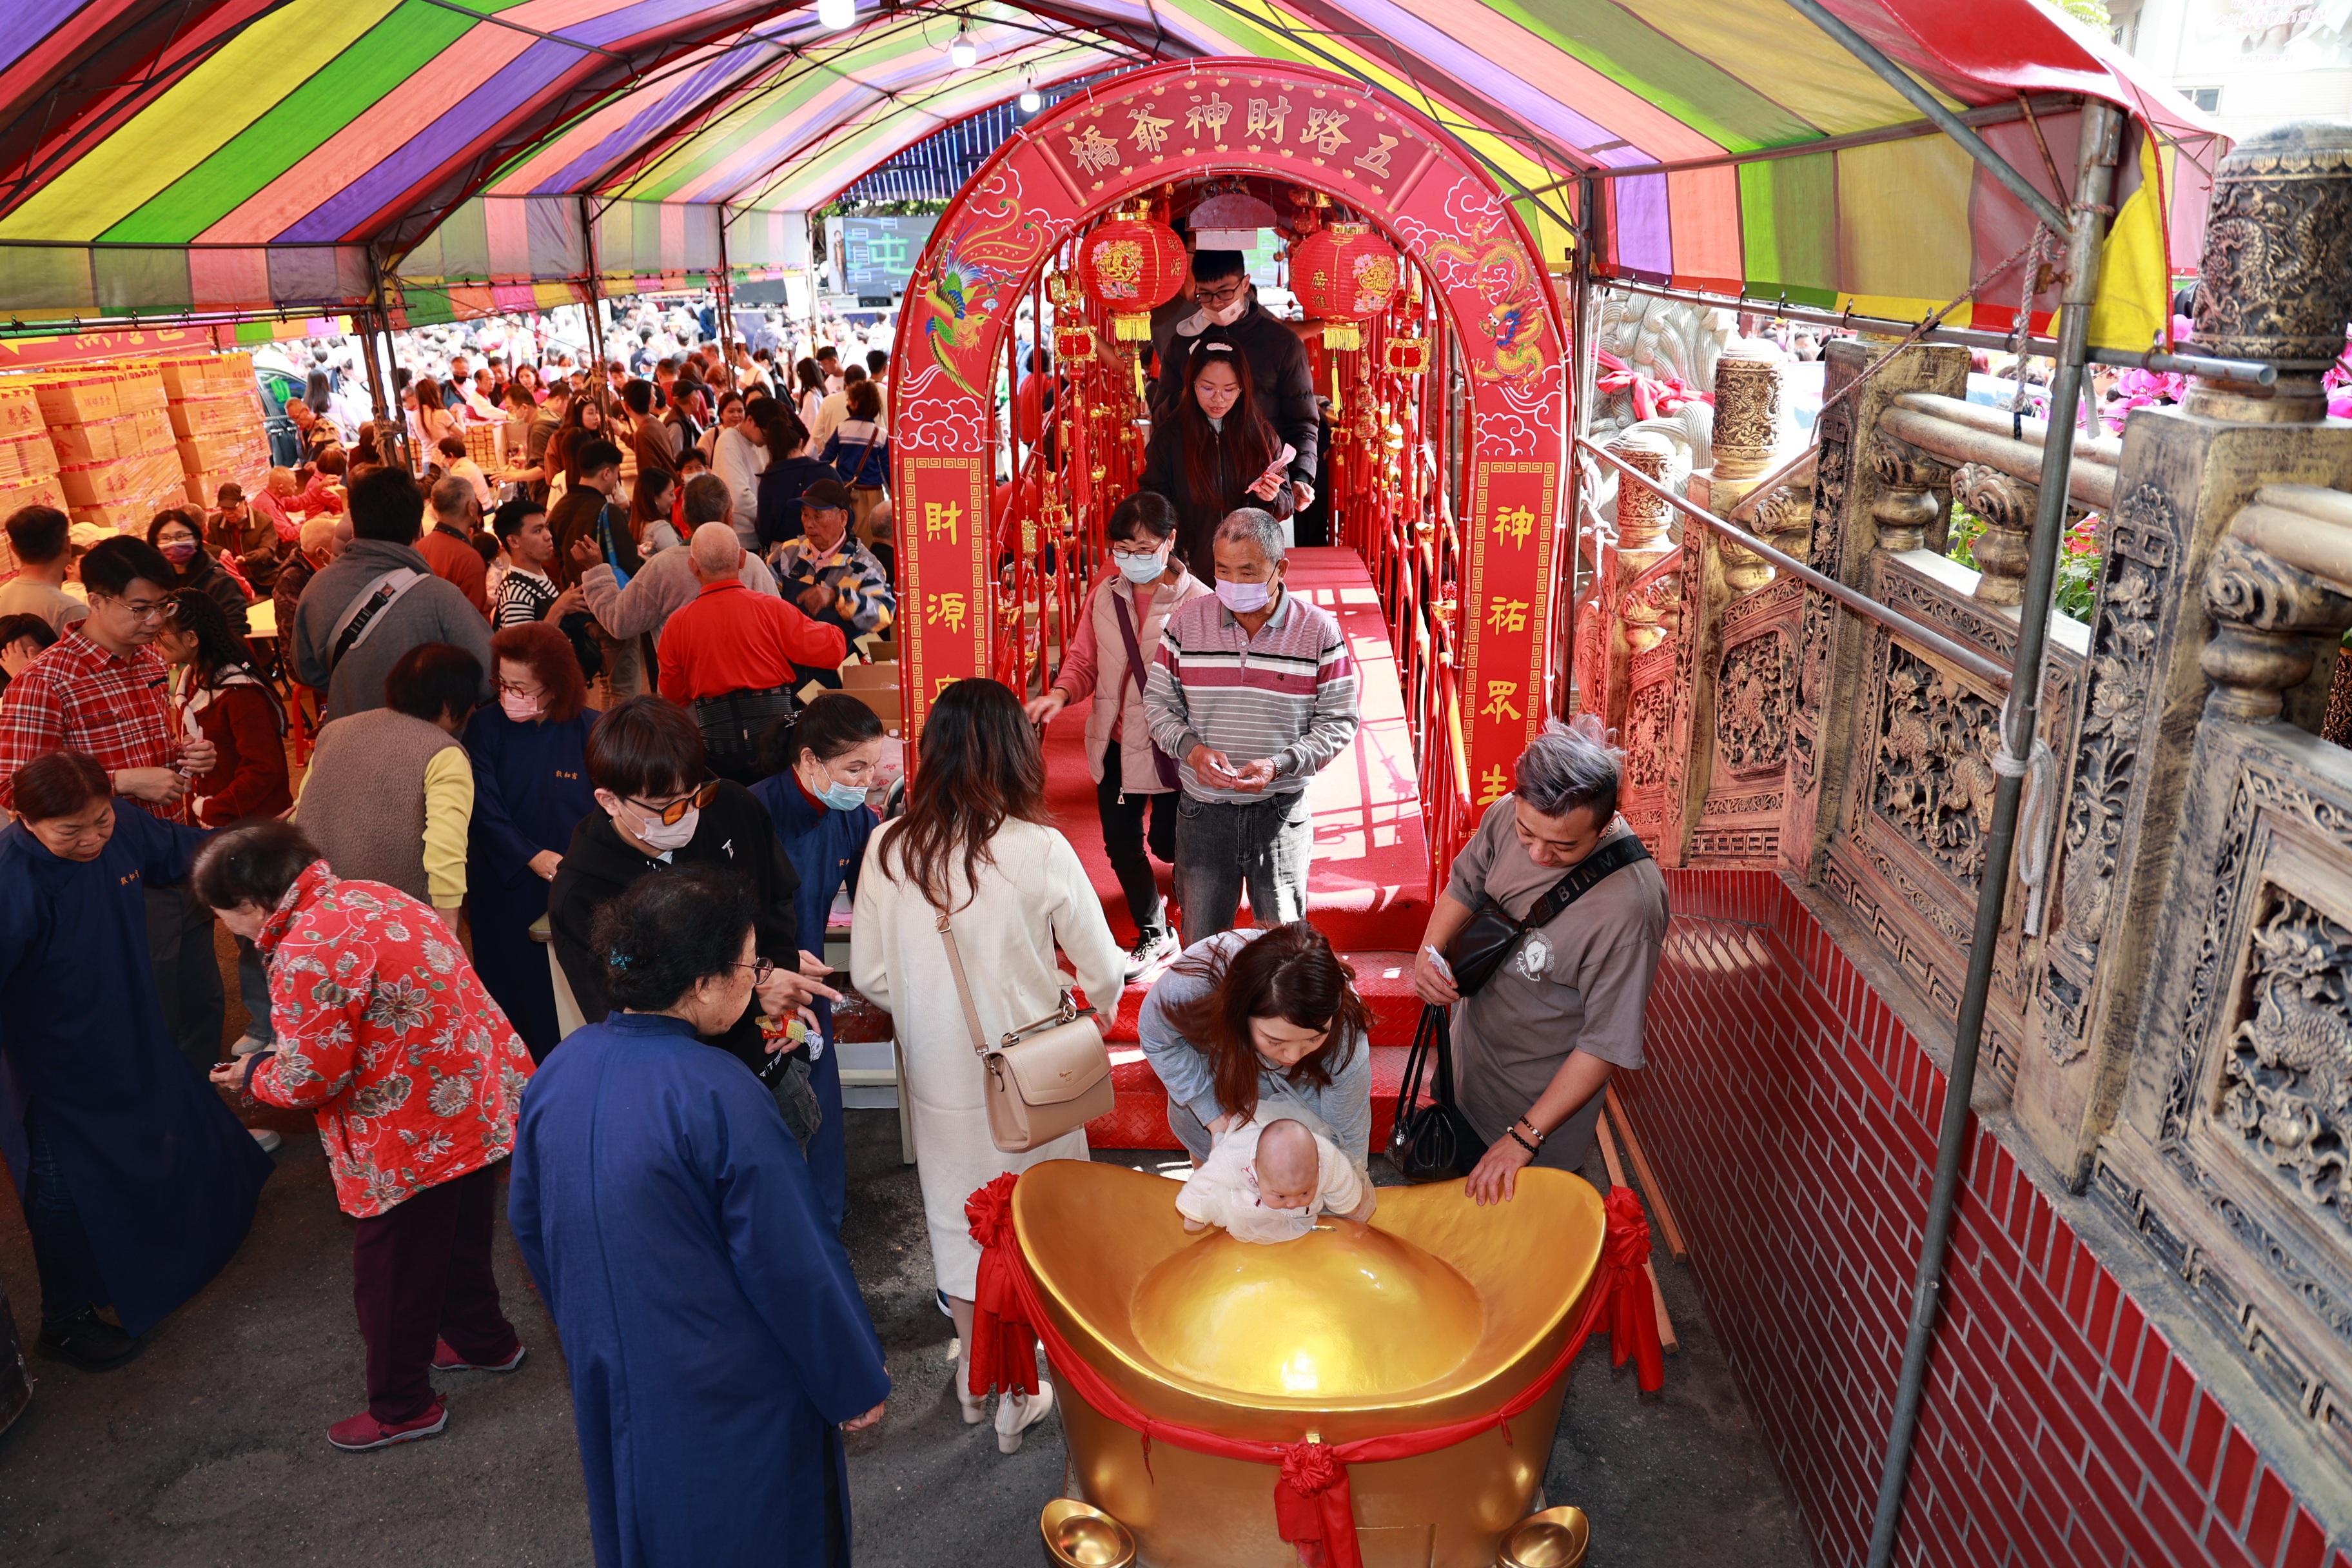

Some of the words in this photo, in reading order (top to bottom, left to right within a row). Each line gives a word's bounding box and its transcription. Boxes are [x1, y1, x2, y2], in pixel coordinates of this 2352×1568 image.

[2233, 55, 2281, 63] CENTURY
[1070, 92, 1399, 179] 五路財神爺橋
[1537, 932, 1553, 952] YOUR
